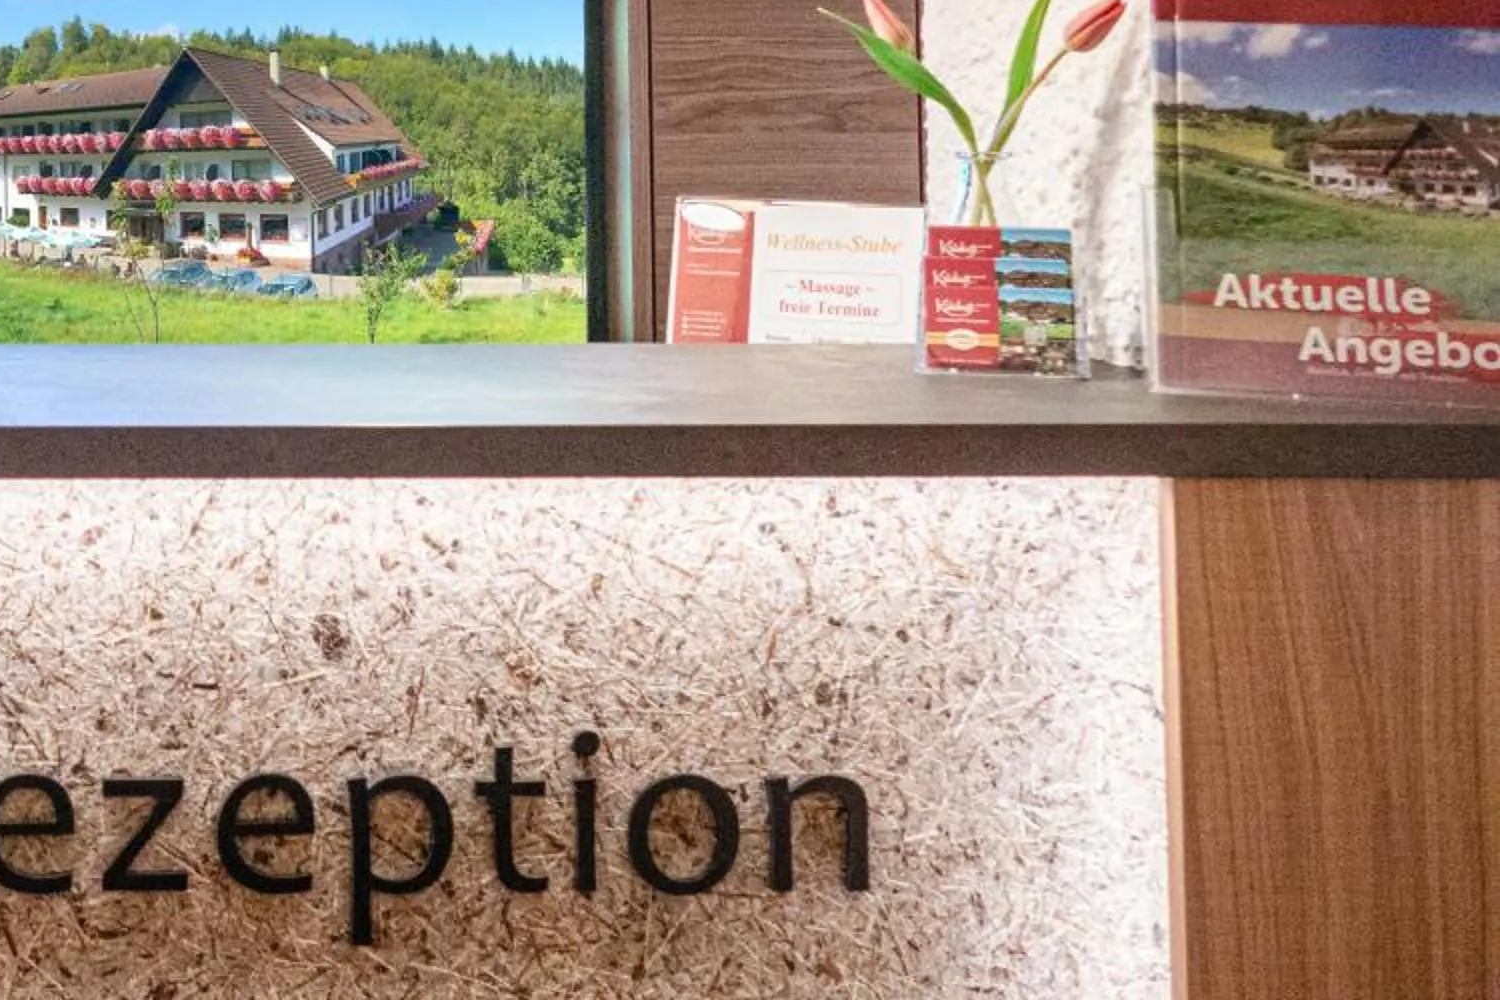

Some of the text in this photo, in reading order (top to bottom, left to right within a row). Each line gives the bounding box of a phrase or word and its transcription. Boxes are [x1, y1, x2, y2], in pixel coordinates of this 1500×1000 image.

[778, 299, 881, 318] freie Termine
[1213, 272, 1432, 316] Aktuelle
